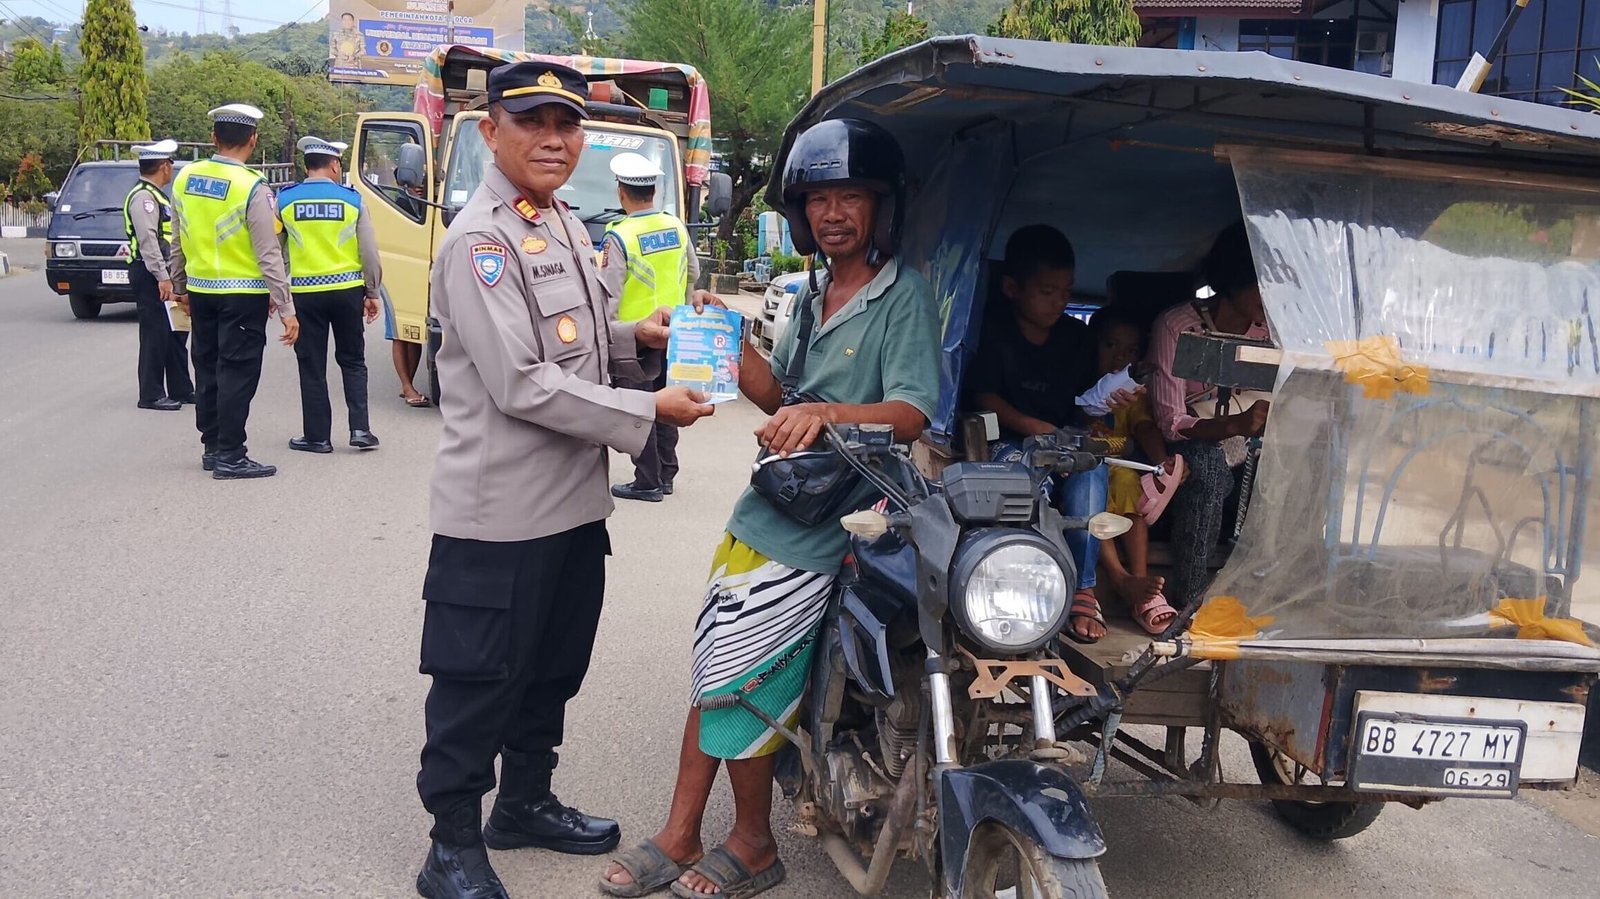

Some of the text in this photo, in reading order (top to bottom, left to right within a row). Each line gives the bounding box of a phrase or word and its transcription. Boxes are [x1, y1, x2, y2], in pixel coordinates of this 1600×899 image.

[380, 11, 424, 19] PEMERINTAH
[401, 41, 431, 50] AWARD
[444, 35, 487, 45] CVERAGE
[186, 177, 229, 198] POLISI
[296, 205, 342, 219] POLISI
[640, 231, 679, 251] POLISI
[532, 262, 567, 279] M.SINAGA
[1366, 726, 1513, 760] BB 4727 MY
